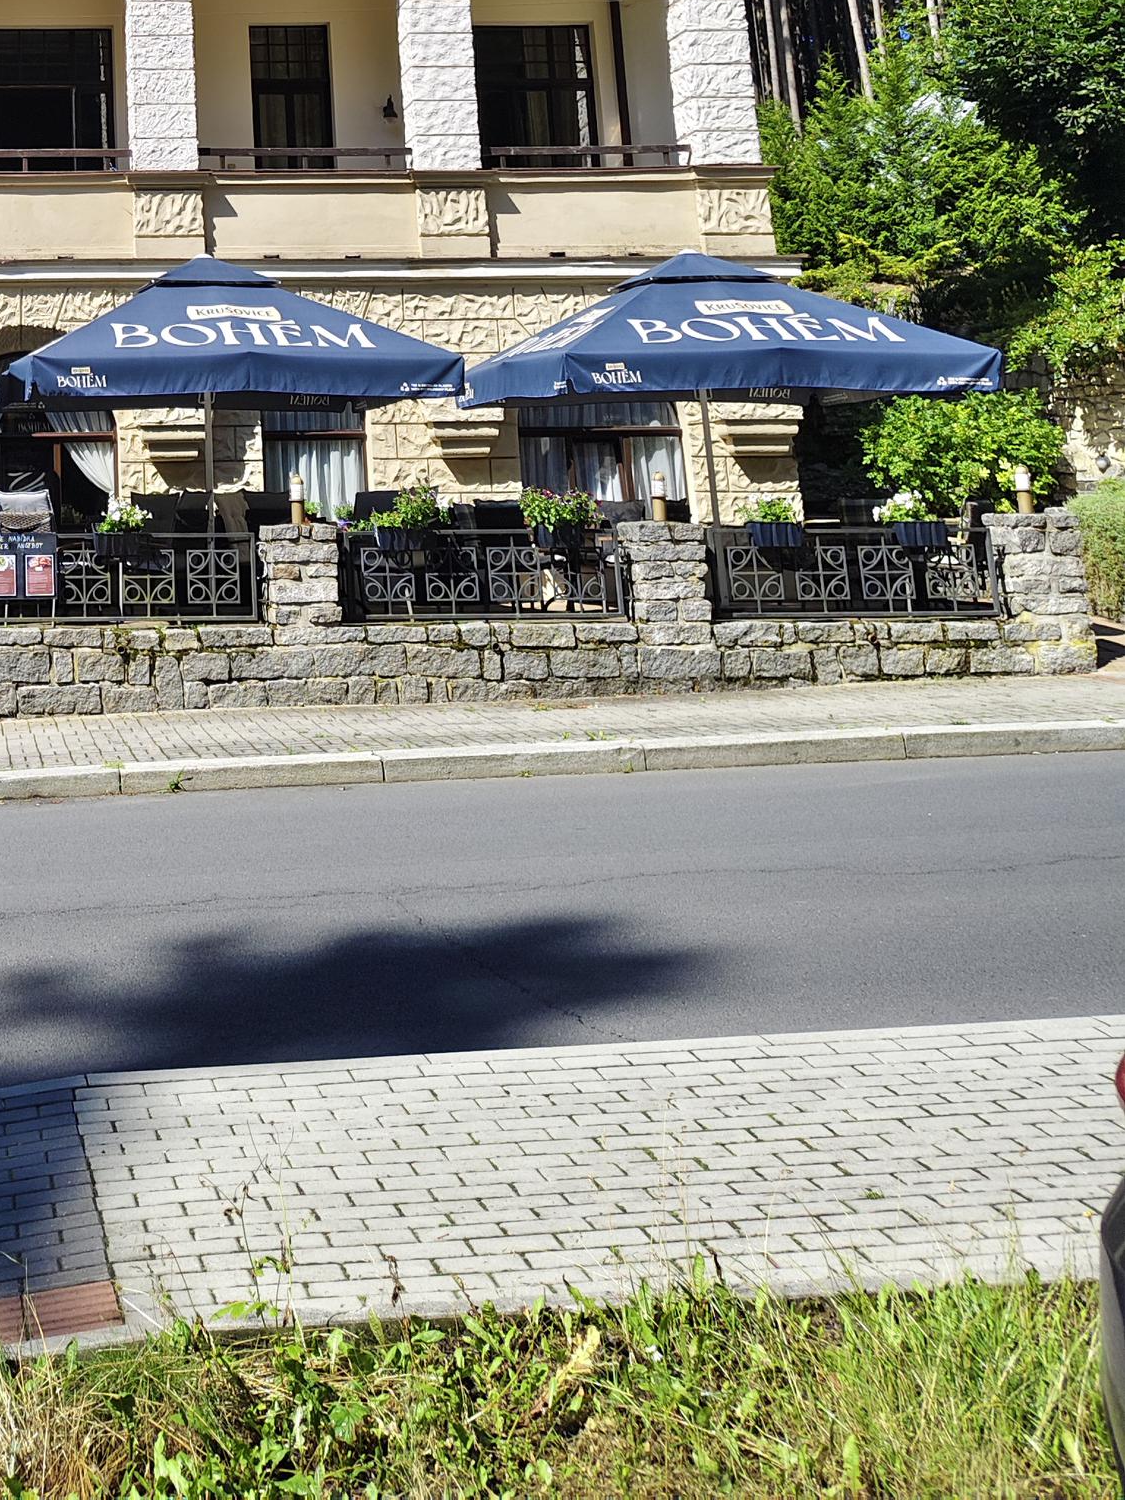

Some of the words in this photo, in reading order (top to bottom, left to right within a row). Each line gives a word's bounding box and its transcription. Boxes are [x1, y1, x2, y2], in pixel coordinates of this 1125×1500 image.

[110, 320, 376, 348] BOHÉM
[627, 313, 906, 344] BOHÉM
[56, 372, 107, 388] BOHÉM
[591, 368, 642, 385] BOHÉM
